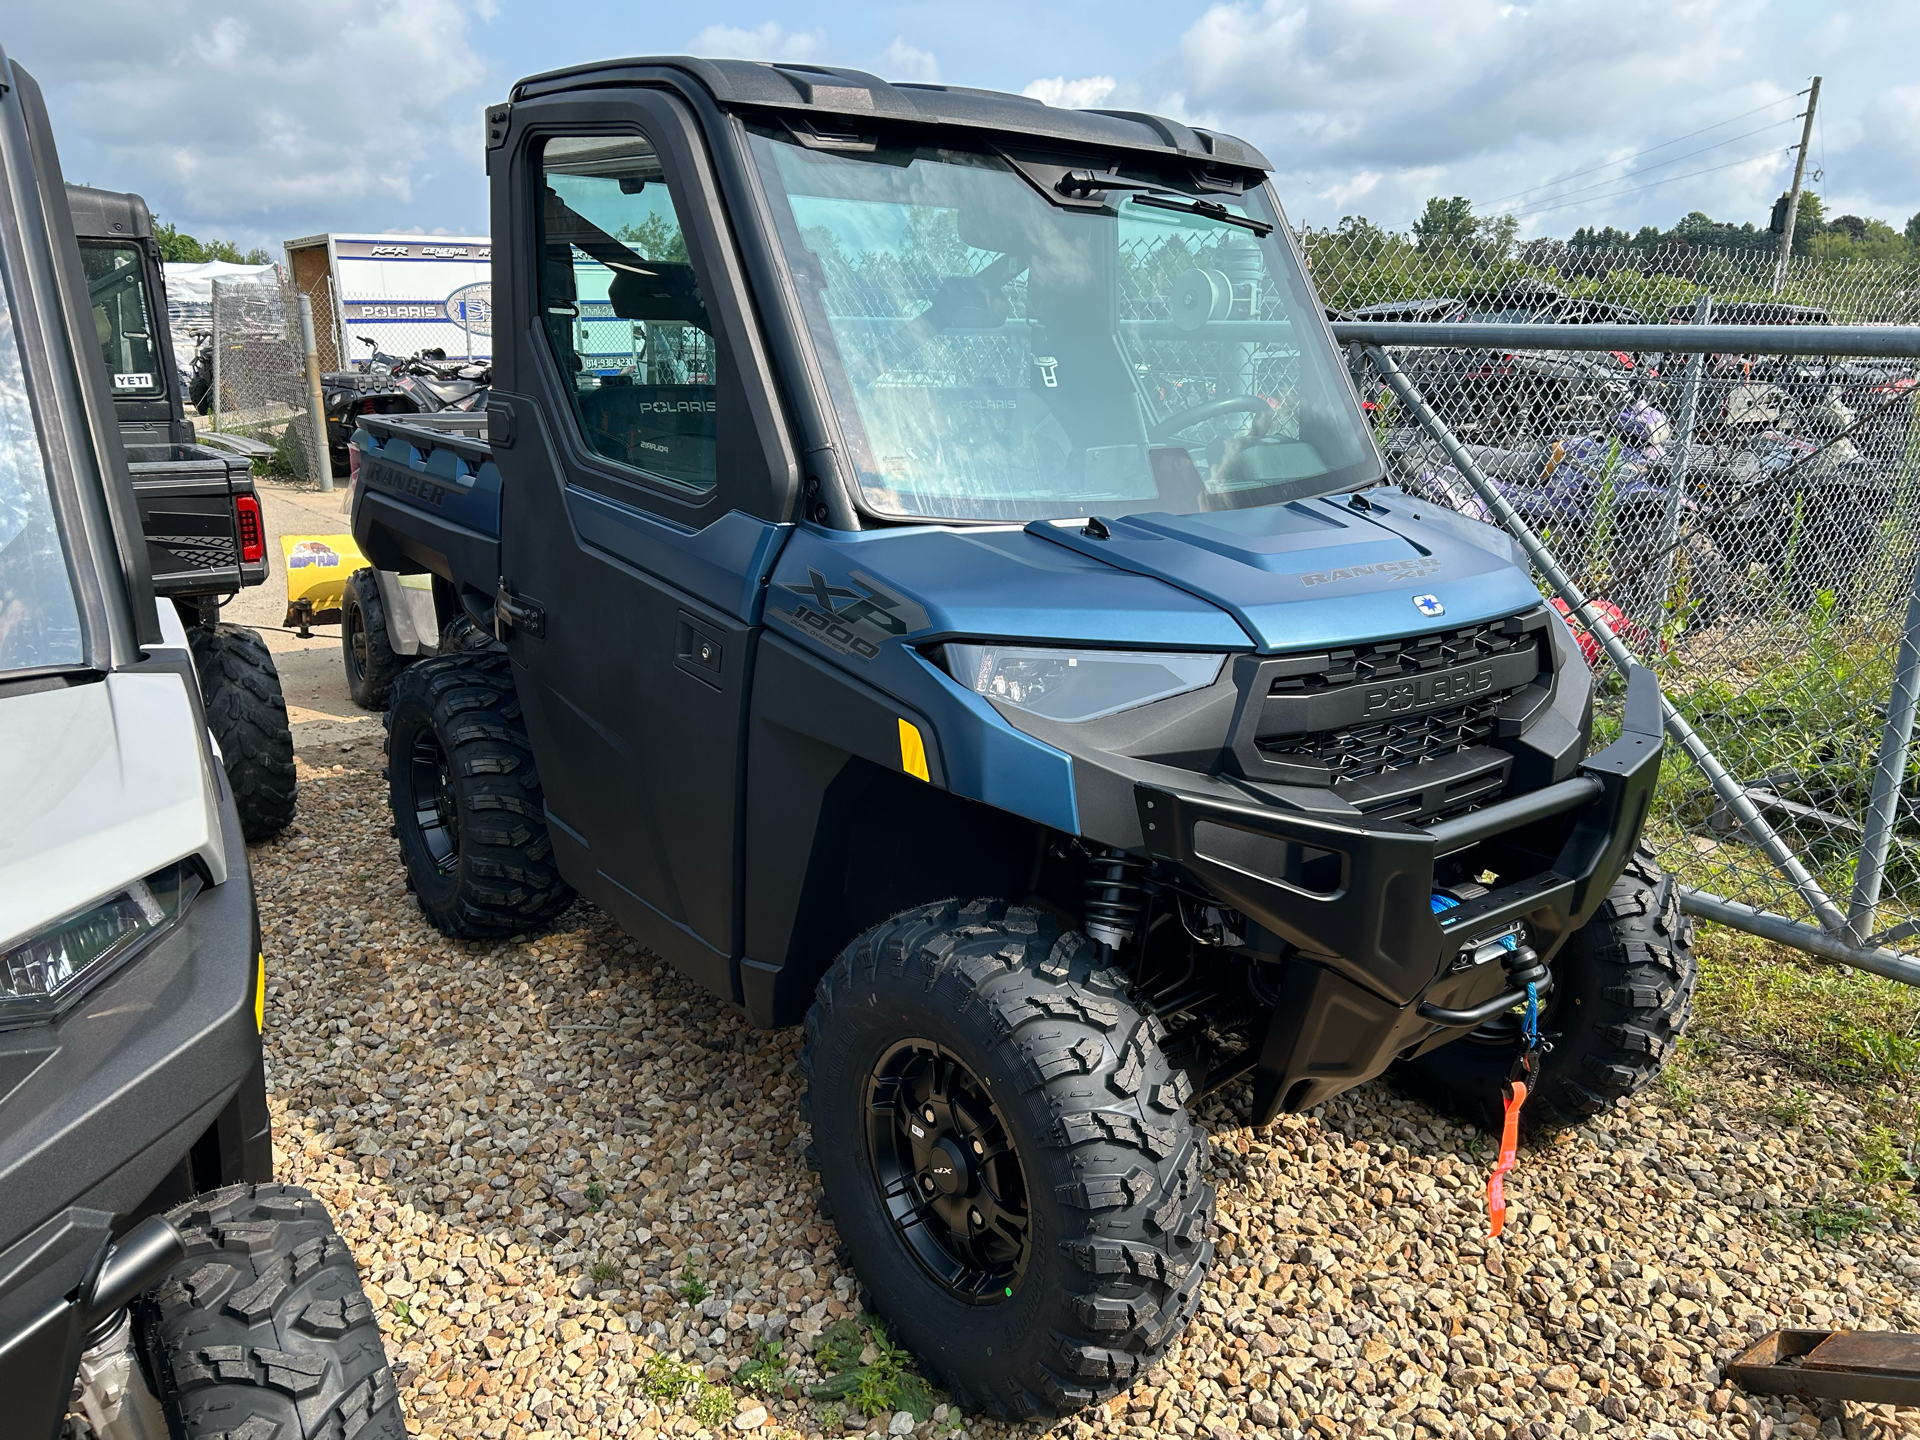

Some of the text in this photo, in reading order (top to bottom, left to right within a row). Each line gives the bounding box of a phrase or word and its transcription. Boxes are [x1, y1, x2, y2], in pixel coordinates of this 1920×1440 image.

[371, 245, 409, 256] RZR
[421, 247, 468, 258] GENERAL
[361, 306, 437, 318] POLARIS
[117, 376, 149, 386] YETI
[640, 401, 716, 414] POLARIS
[960, 399, 1017, 410] POLARIS
[367, 462, 447, 507] RANGER
[1300, 557, 1443, 588] RANGER
[1387, 567, 1442, 583] XP
[782, 565, 912, 636] XP
[790, 619, 810, 633] DUAL
[809, 629, 851, 656] OVERHEAD
[793, 604, 882, 660] 1000
[1362, 664, 1493, 718] POLARIS
[1491, 1150, 1516, 1212] POARIS
